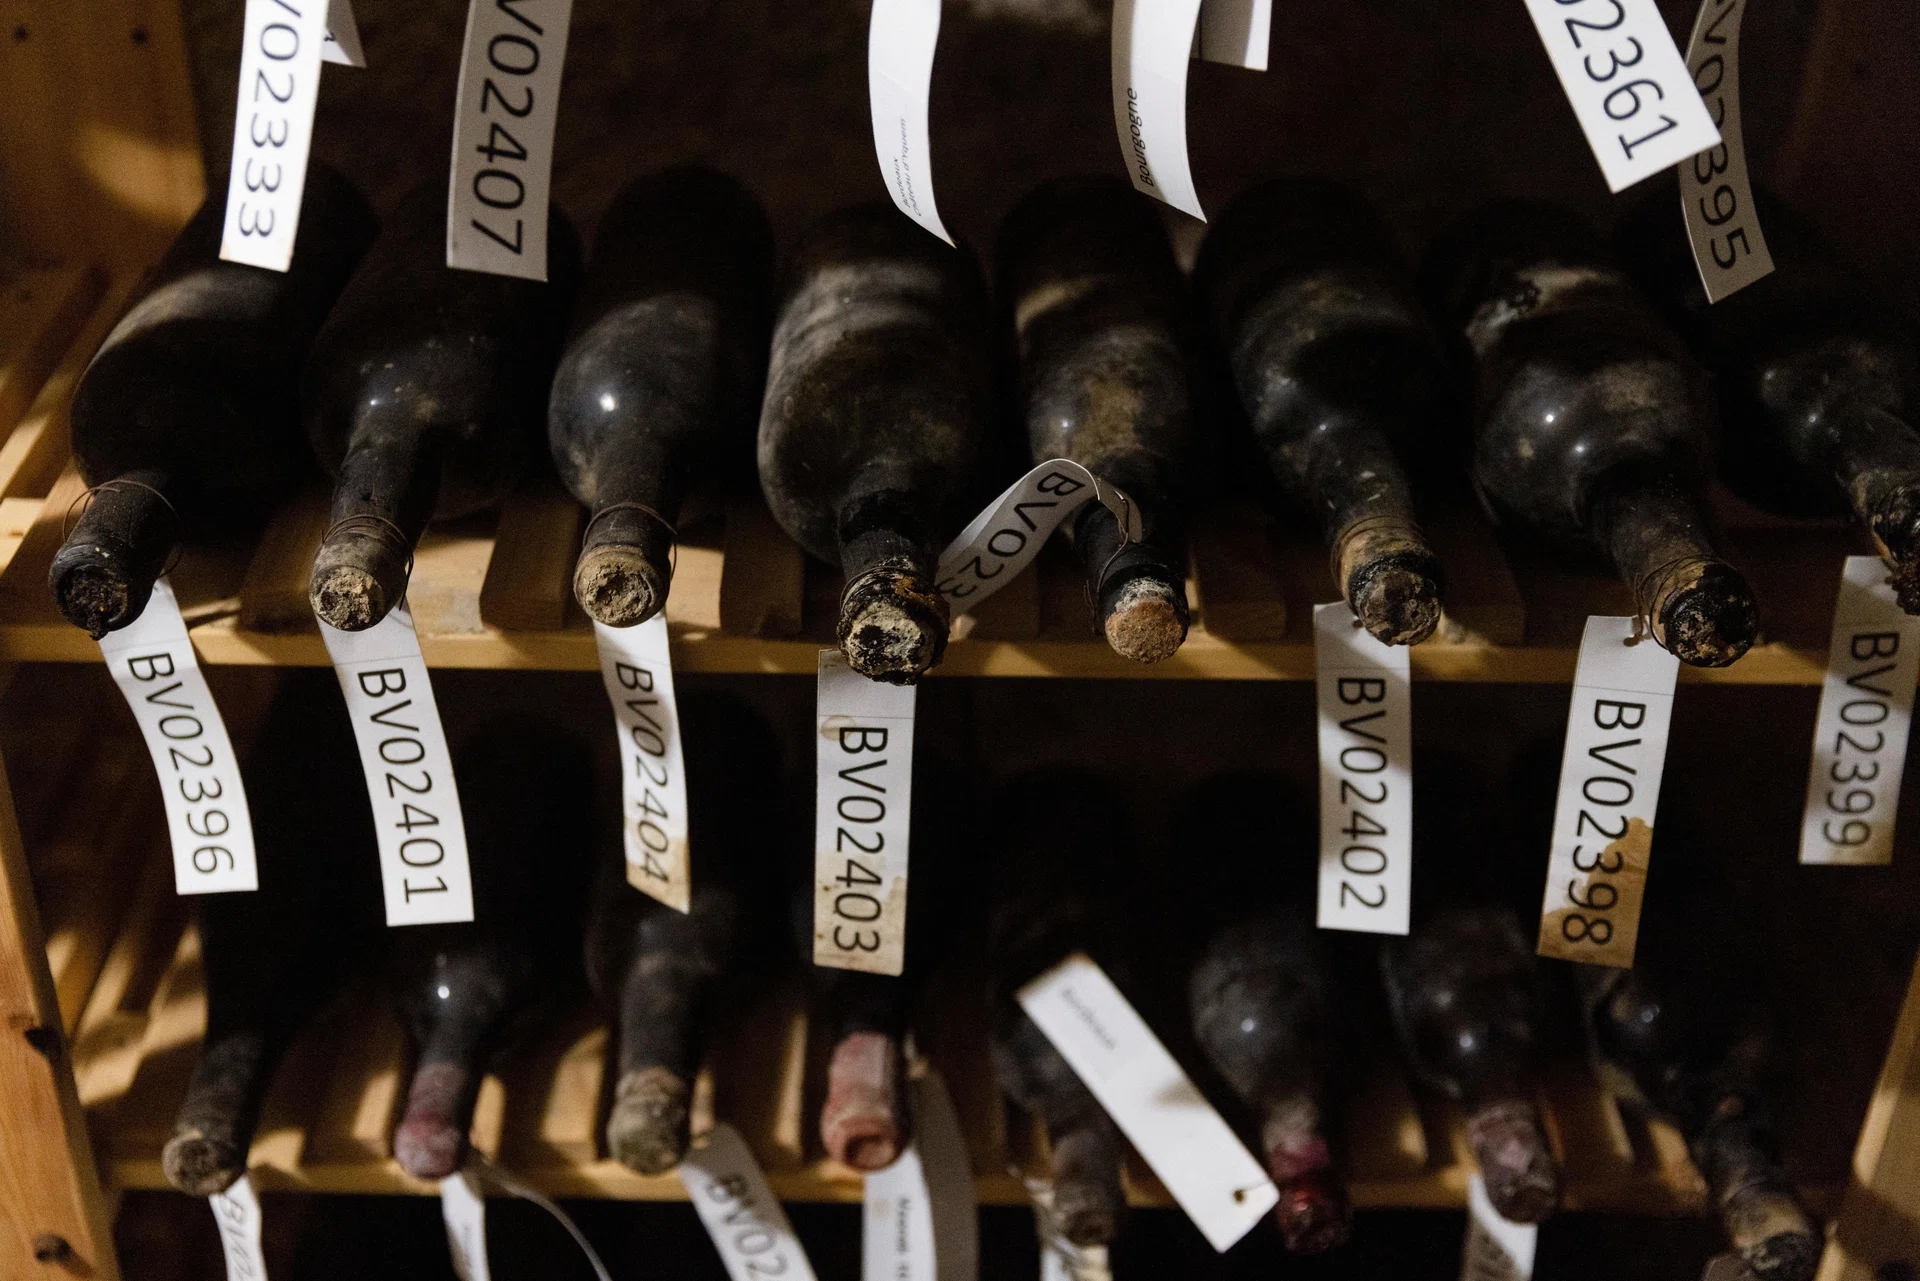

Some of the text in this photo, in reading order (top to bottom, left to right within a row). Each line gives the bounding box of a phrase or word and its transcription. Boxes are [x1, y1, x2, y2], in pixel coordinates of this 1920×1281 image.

[893, 156, 911, 208] Bordeaux
[1127, 87, 1155, 187] Bourgogne
[1554, 0, 1677, 160] 2361
[1694, 0, 1751, 269] V0395
[935, 471, 1086, 598] BV023
[127, 652, 234, 874] BV02396
[357, 667, 448, 904] BV02401
[615, 661, 670, 884] BV02404
[834, 726, 888, 952] BV02403
[1337, 677, 1388, 910] BV02402
[1562, 699, 1647, 946] BV02398
[1823, 631, 1900, 847] BV02399
